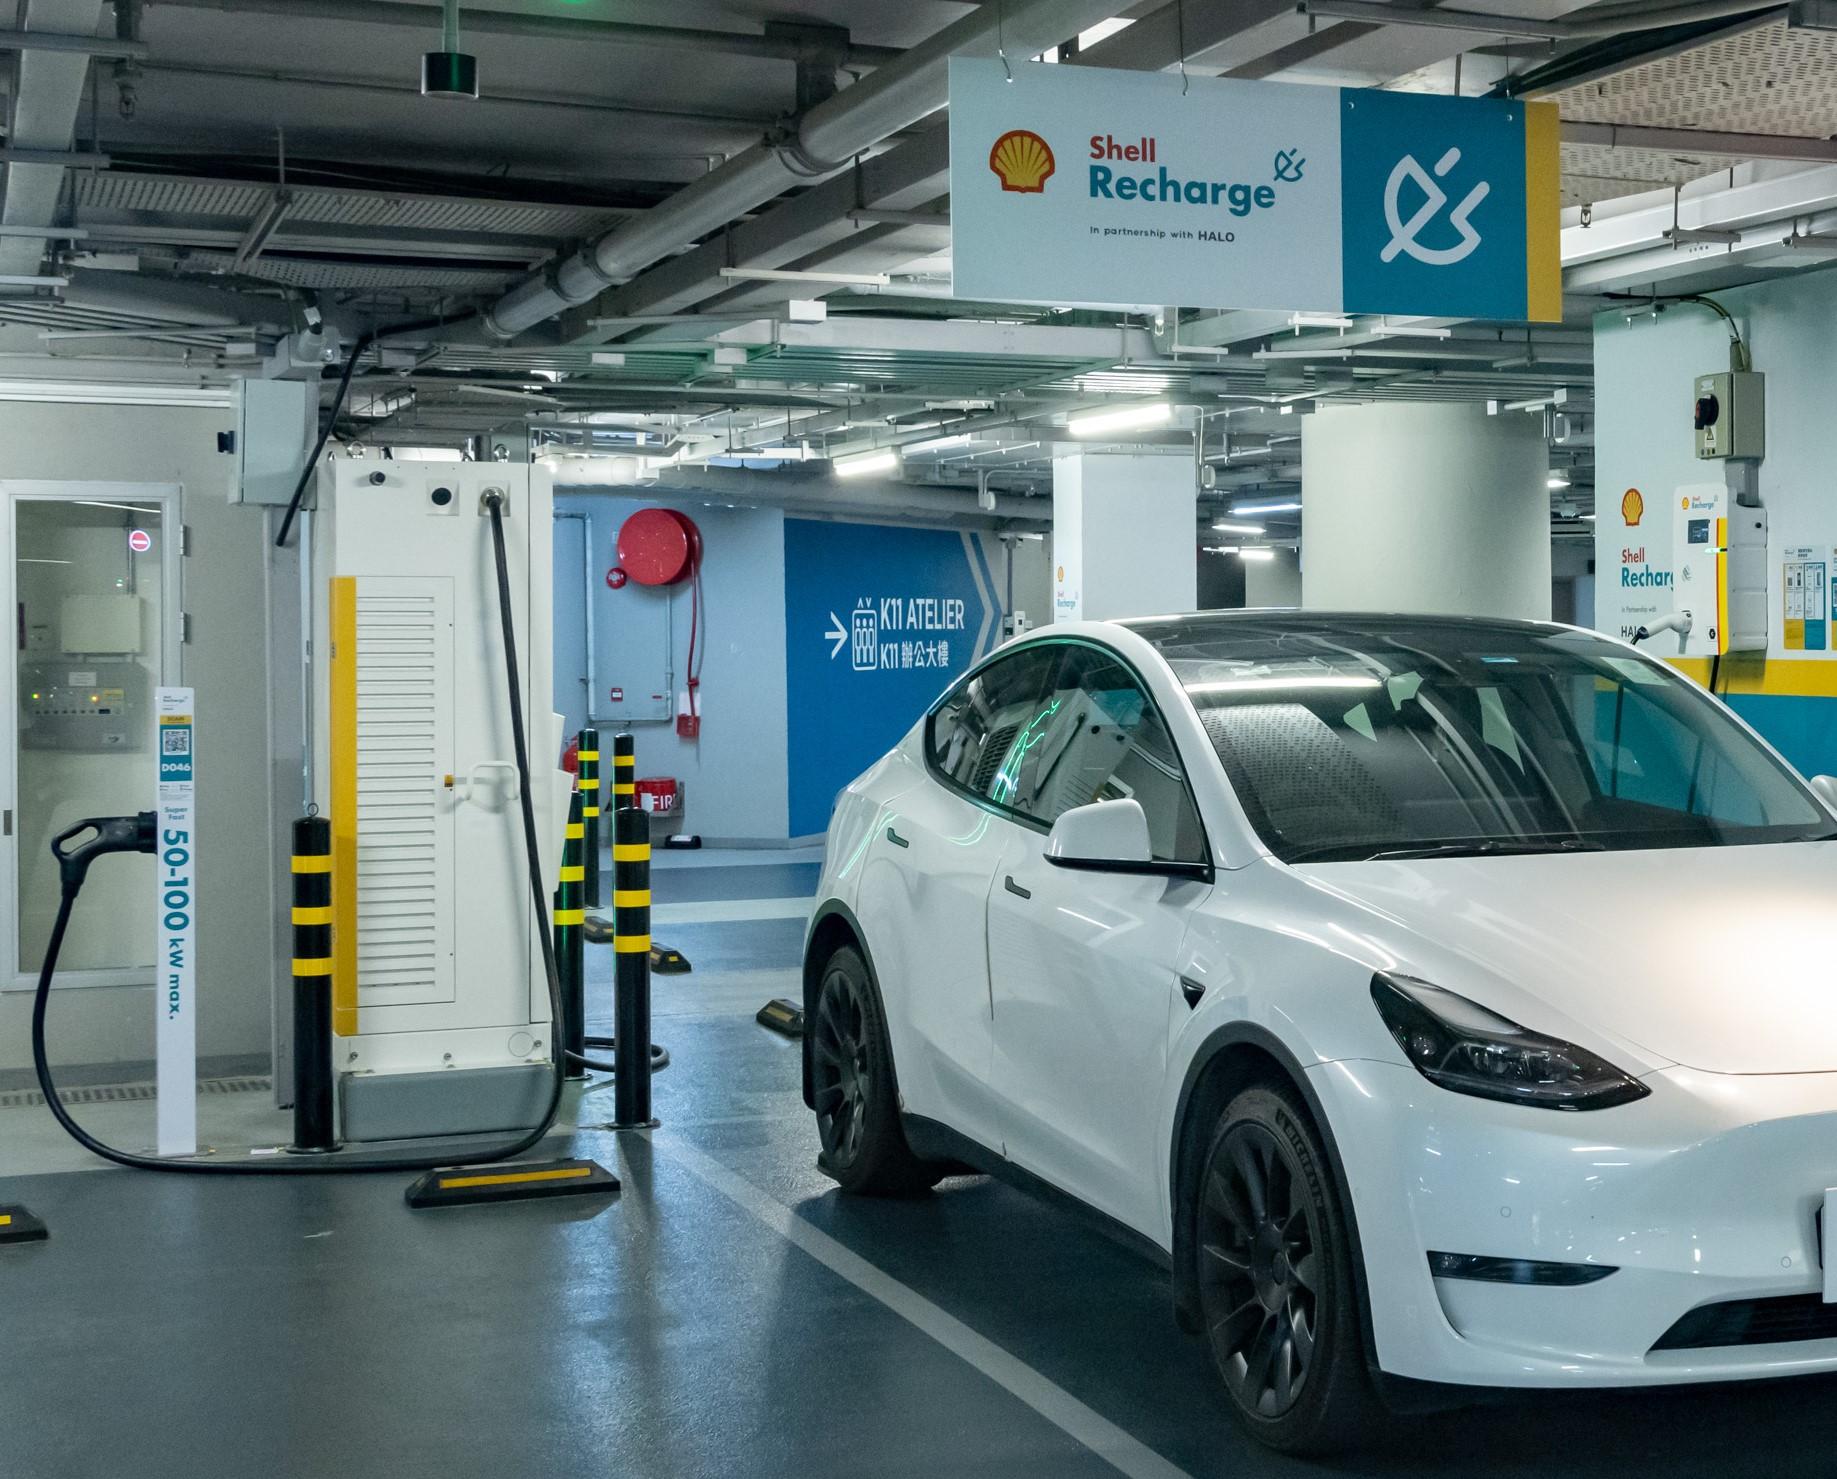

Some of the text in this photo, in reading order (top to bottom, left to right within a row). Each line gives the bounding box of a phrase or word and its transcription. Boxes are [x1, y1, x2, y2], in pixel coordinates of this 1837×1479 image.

[1089, 134, 1156, 162] Shell
[1089, 164, 1275, 217] Recharge
[1090, 226, 1235, 242] In partnership with HALO
[1622, 547, 1645, 563] Shell
[1621, 564, 1674, 592] Rechar
[880, 598, 965, 630] K11 ATELIER
[1621, 625, 1638, 638] HAL
[880, 640, 949, 670] K11 辦公大樓
[161, 763, 191, 772] D046
[164, 806, 188, 814] Super
[652, 793, 676, 810] FIR
[163, 828, 190, 1020] 50-100 kW max.
